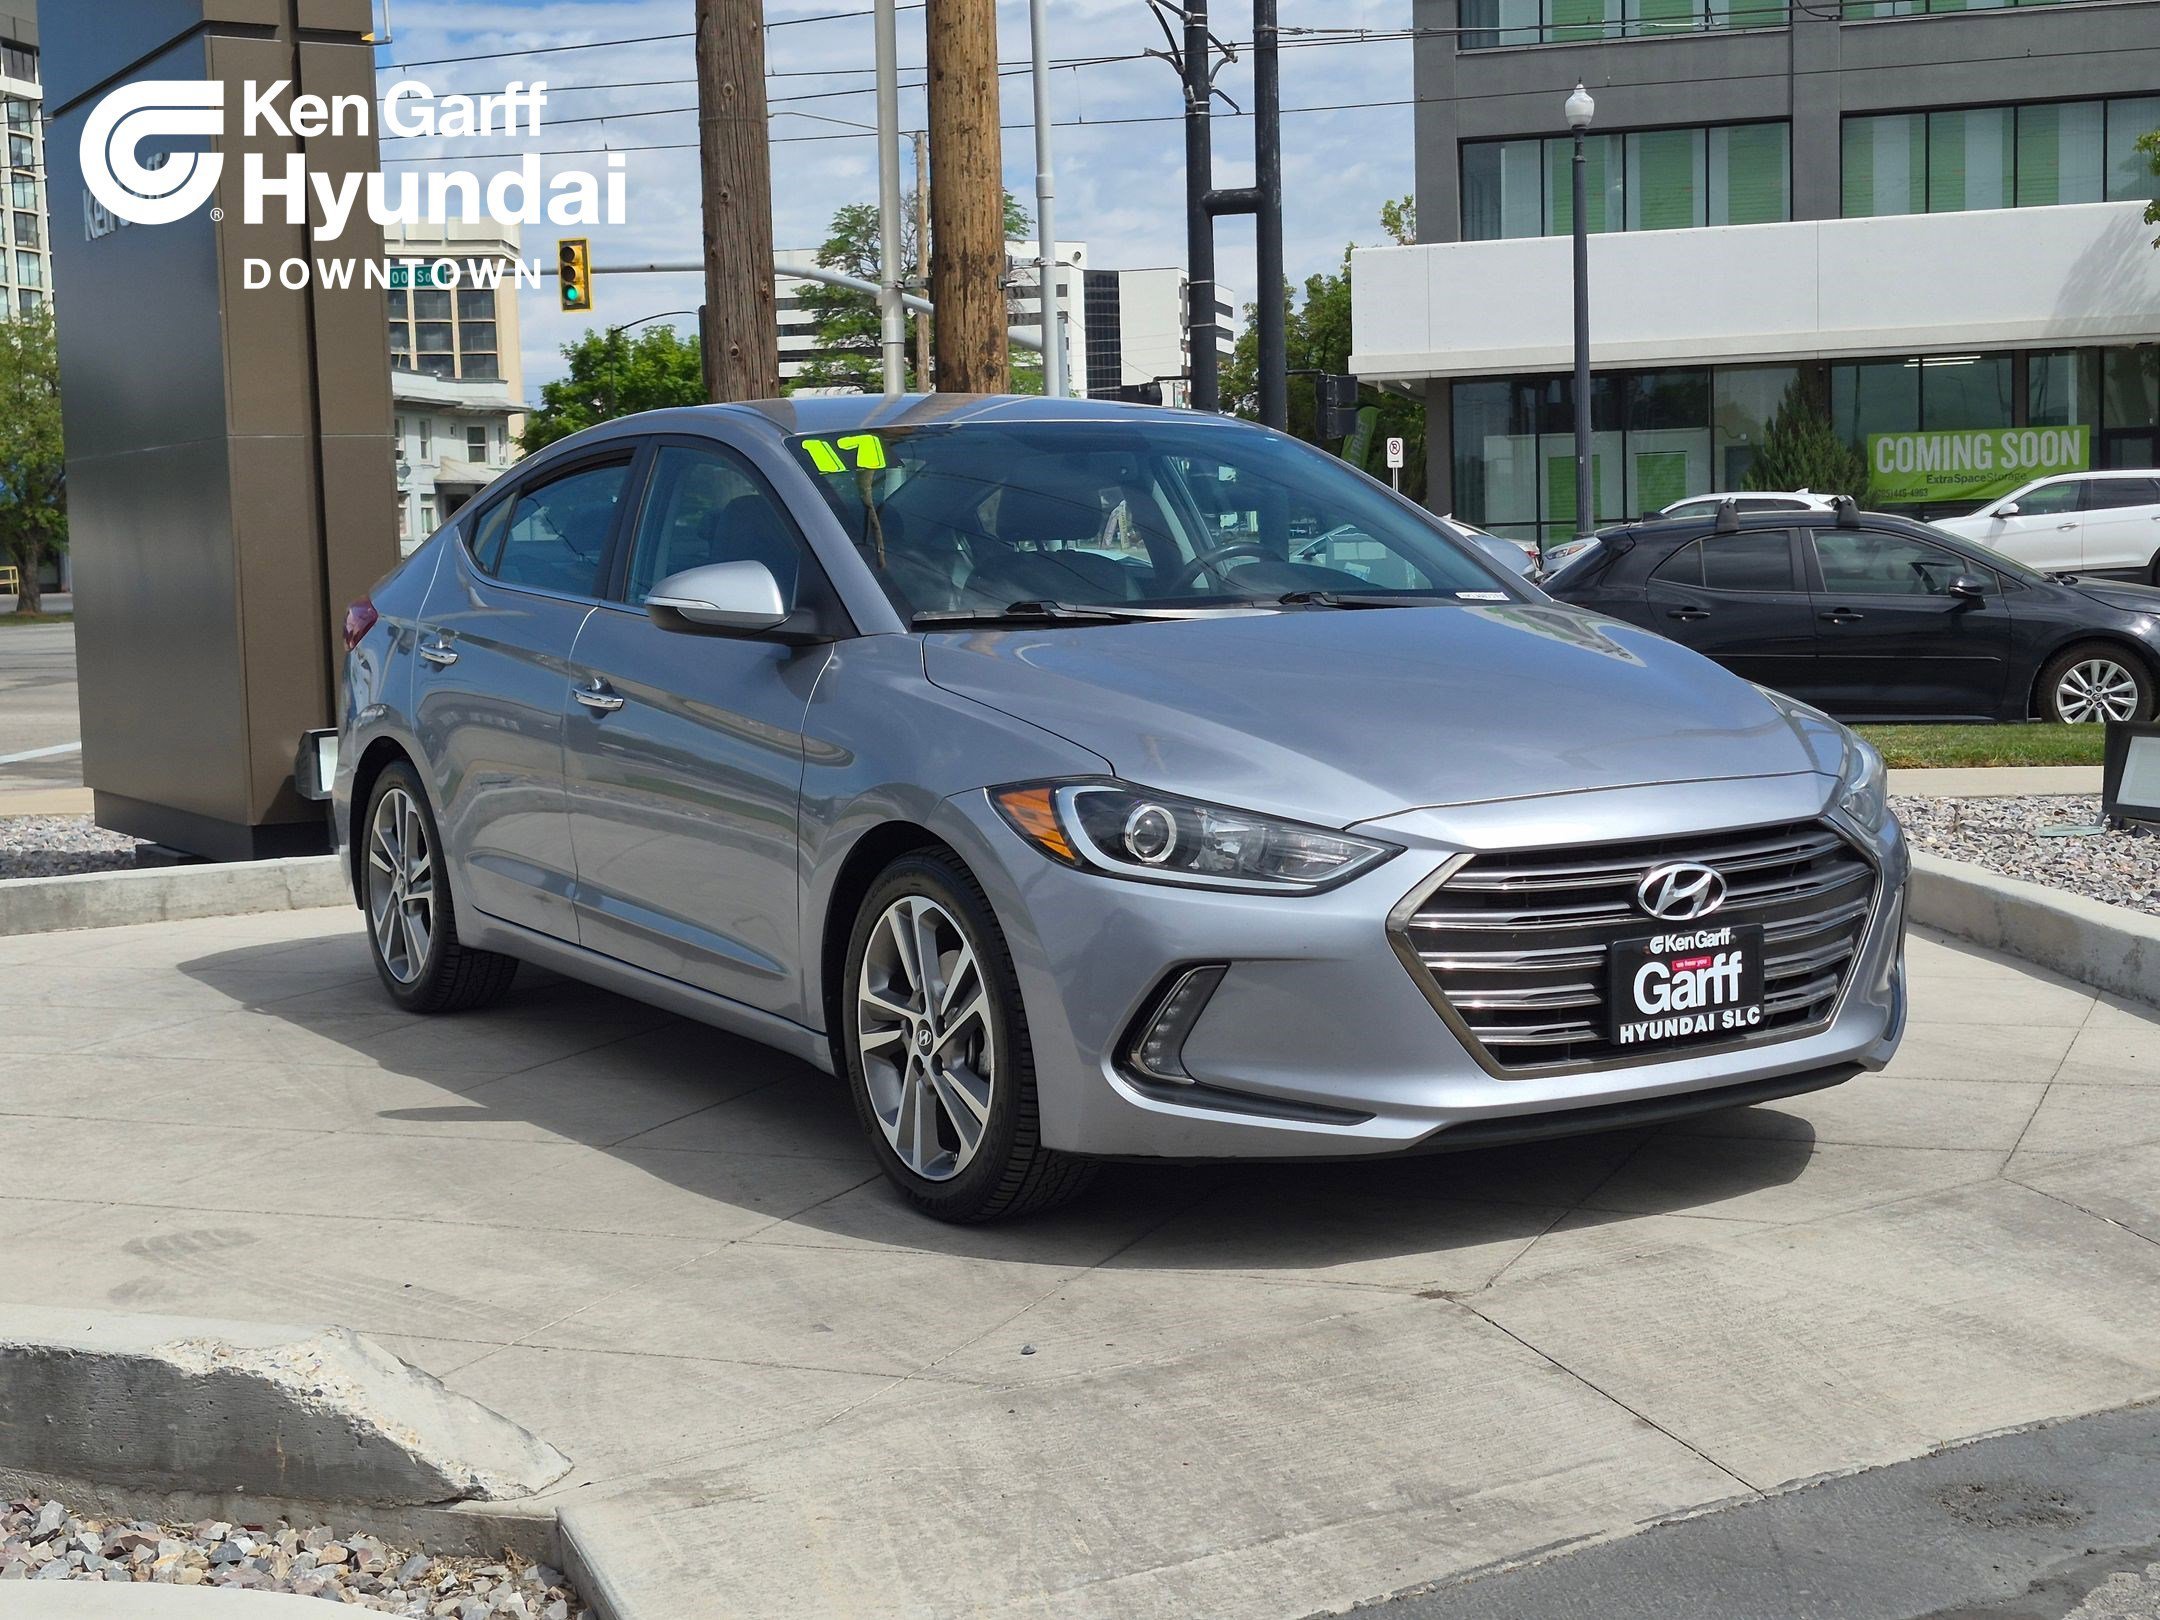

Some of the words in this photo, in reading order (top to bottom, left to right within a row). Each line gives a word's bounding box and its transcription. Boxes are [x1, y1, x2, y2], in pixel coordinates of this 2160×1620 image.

[801, 434, 886, 473] 17
[1876, 432, 1993, 473] COMING
[2000, 430, 2080, 468] SOON
[1665, 933, 1694, 953] Ken
[1695, 927, 1731, 949] Garff
[1633, 951, 1743, 1015] Garff
[1620, 1013, 1715, 1044] HYUNDAI
[1722, 1004, 1761, 1029] SLC
